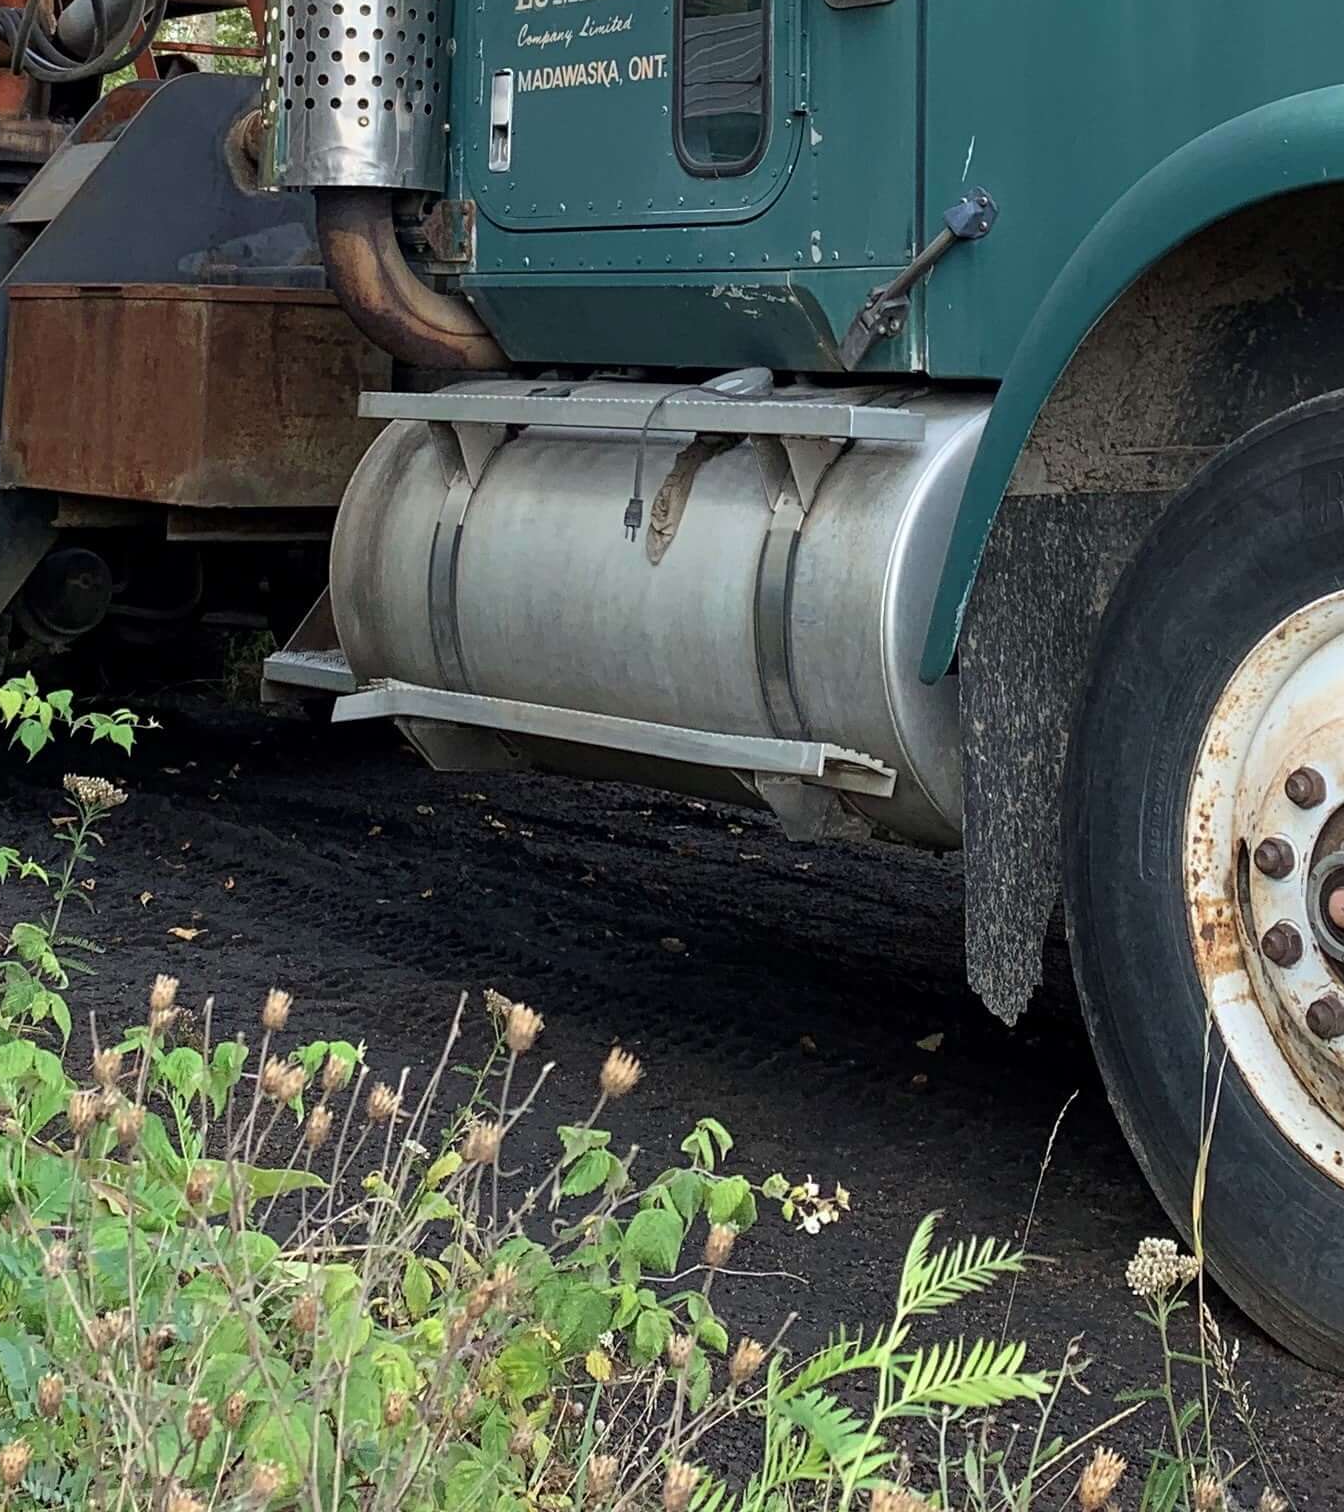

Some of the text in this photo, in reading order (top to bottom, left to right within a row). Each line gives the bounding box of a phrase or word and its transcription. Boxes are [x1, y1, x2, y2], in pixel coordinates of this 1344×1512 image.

[517, 14, 632, 50] Company Limited
[518, 54, 668, 93] MADAWASKA, ONT.
